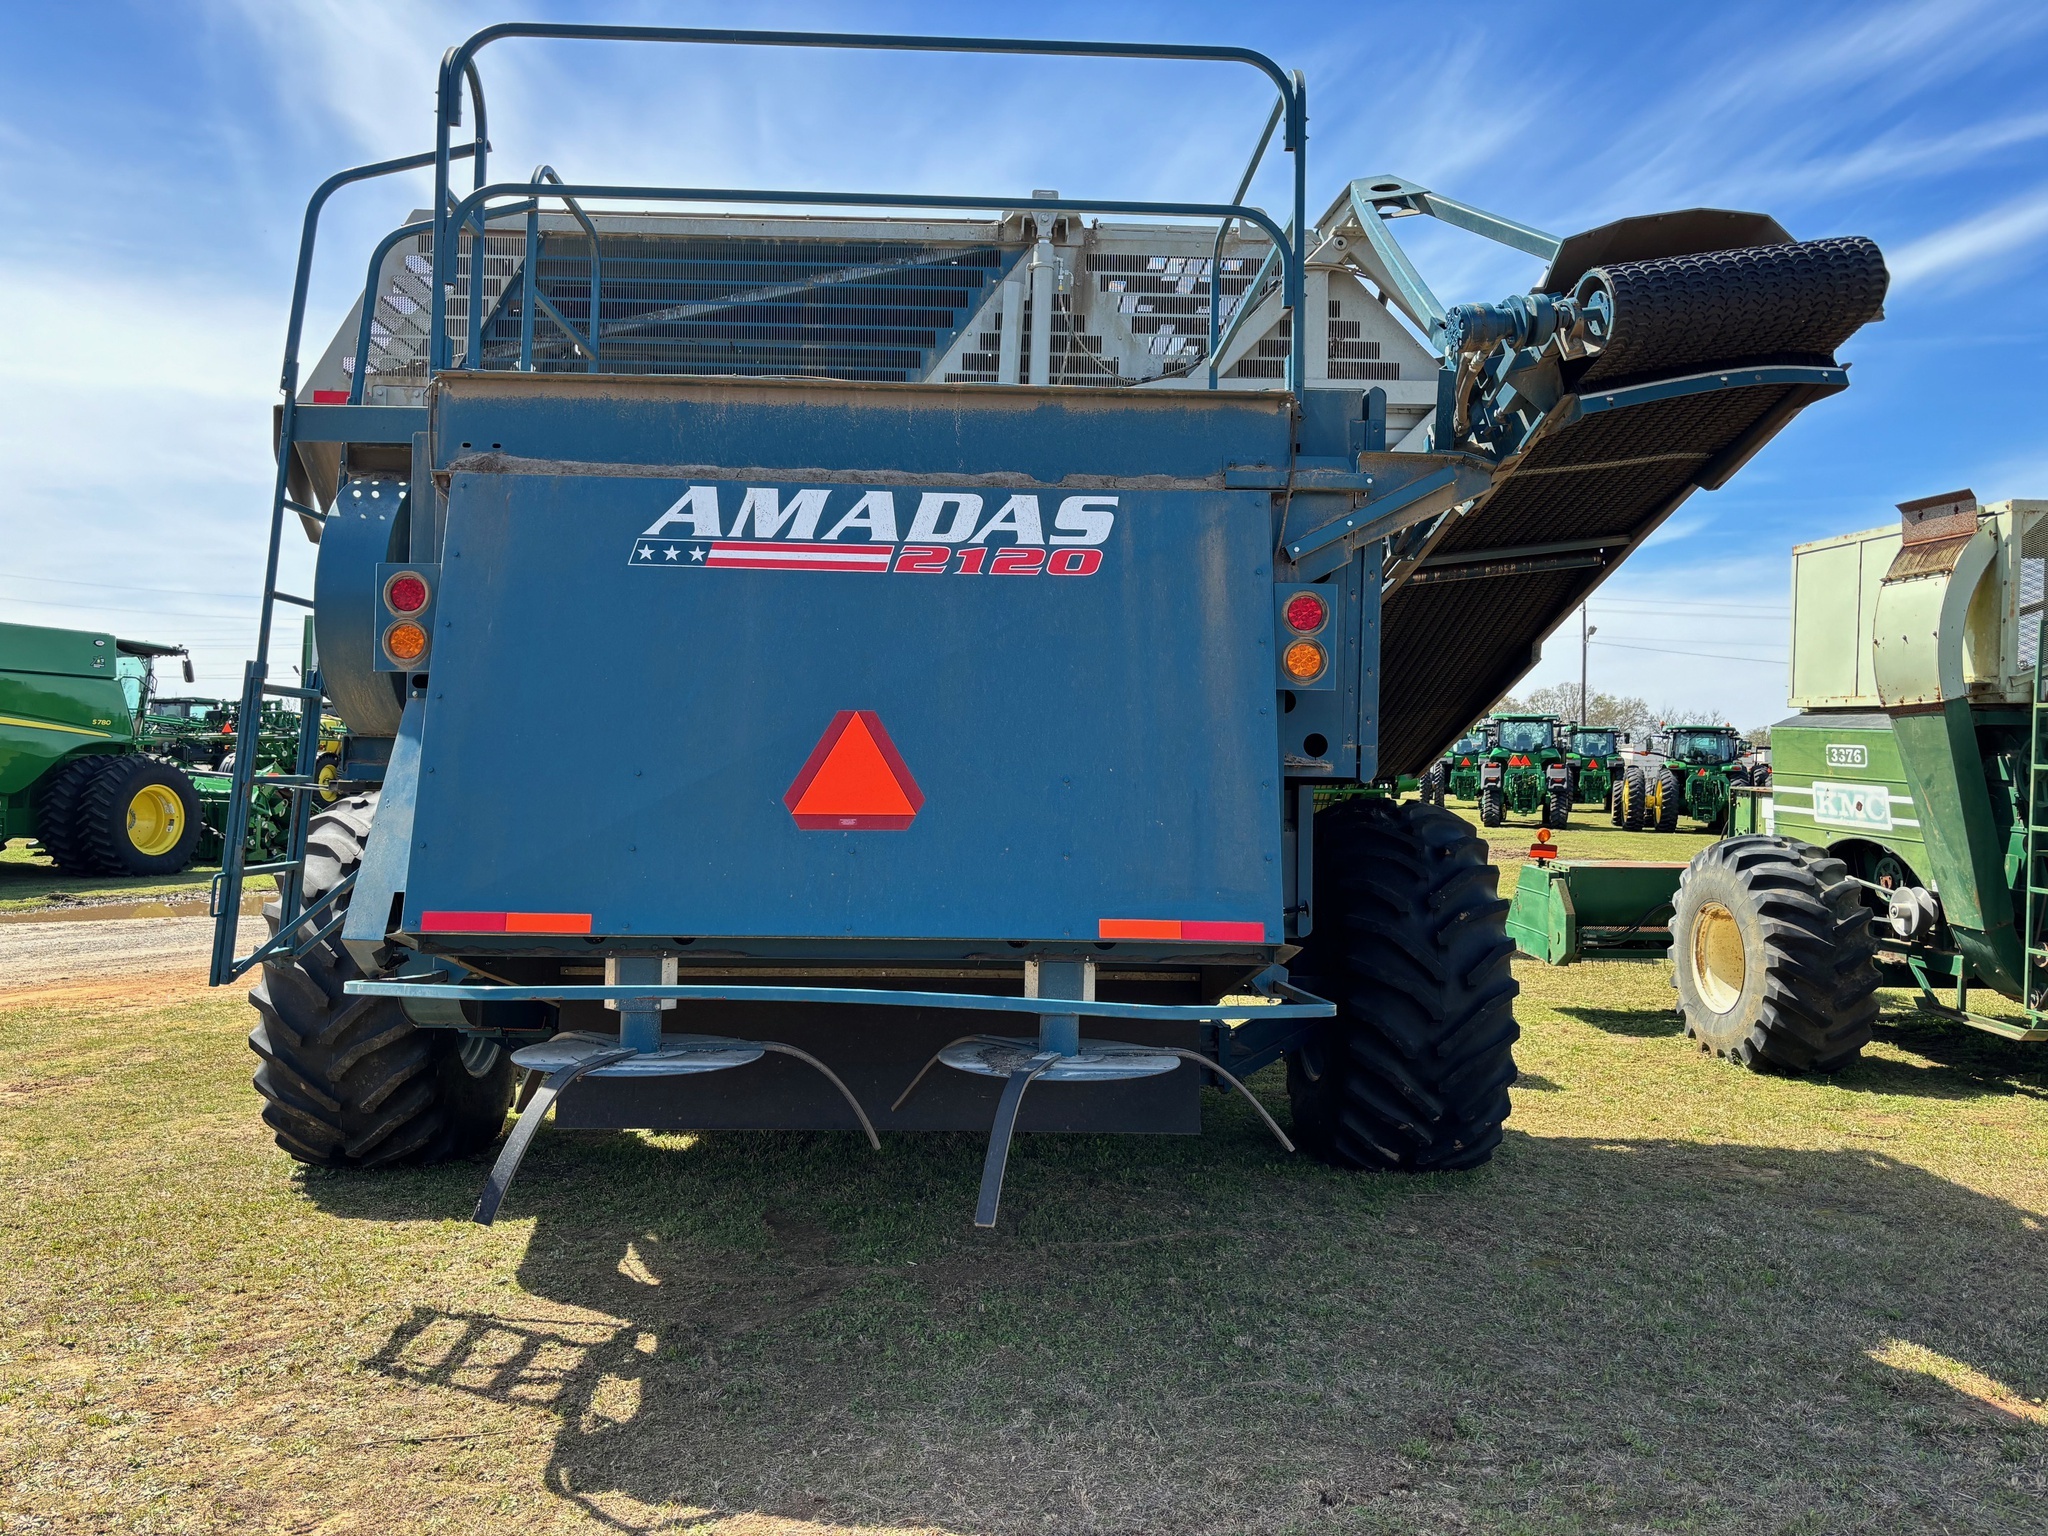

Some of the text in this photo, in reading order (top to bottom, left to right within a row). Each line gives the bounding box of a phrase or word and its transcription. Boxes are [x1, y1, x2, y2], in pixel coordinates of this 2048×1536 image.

[642, 486, 1119, 545] AMADAS
[893, 545, 1104, 577] 2120
[1830, 748, 1862, 763] 3376
[1816, 790, 1886, 820] KMC
